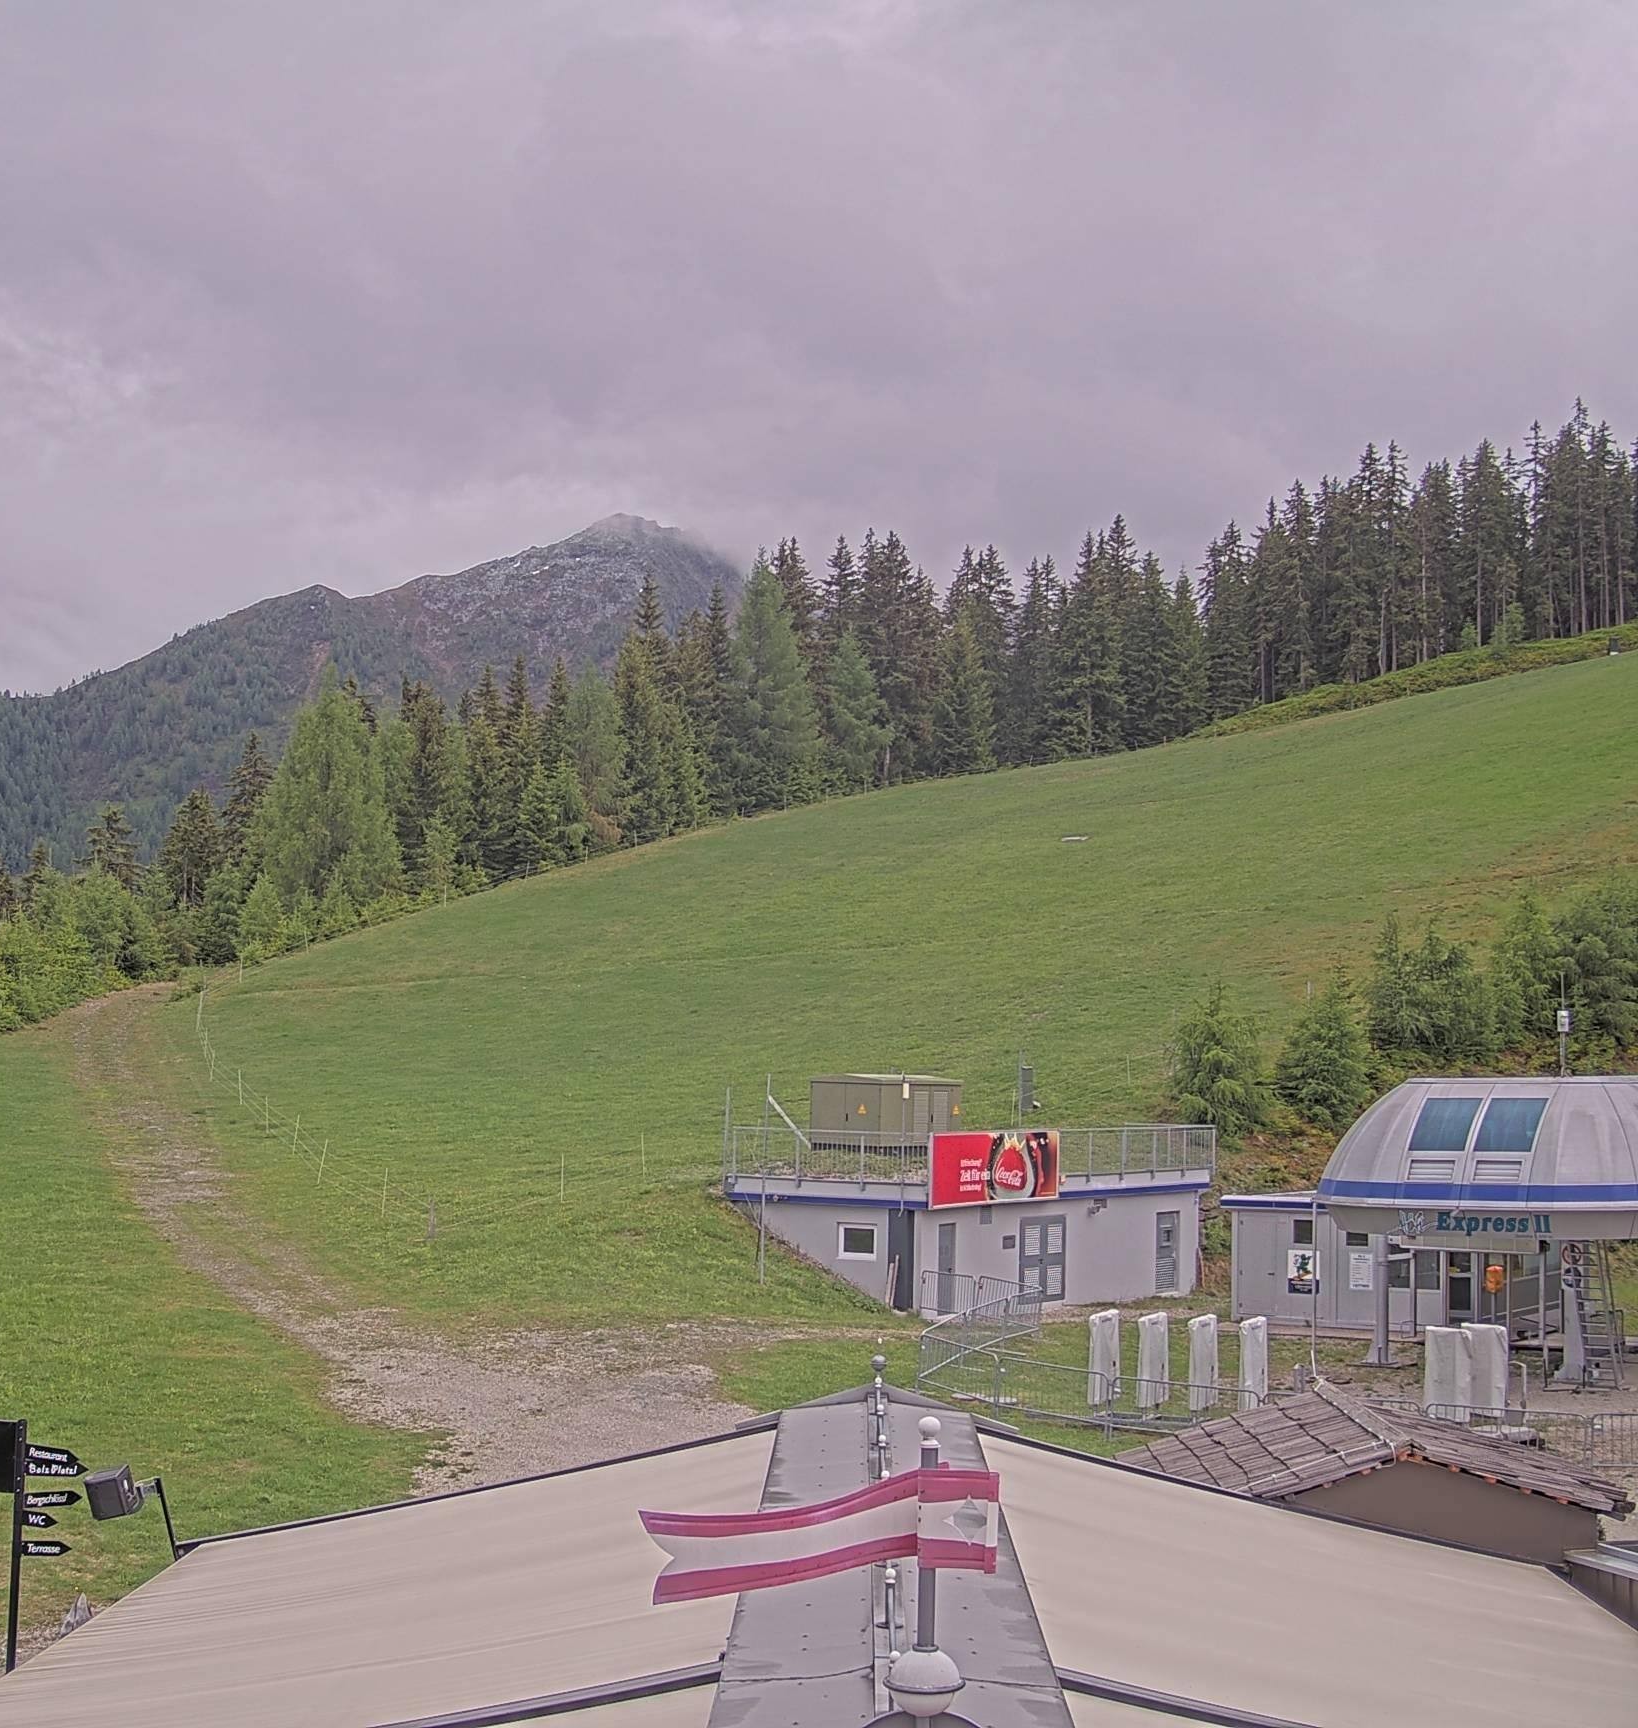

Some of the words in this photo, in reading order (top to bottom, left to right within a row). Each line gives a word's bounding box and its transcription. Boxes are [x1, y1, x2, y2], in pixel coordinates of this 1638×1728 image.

[1436, 1211, 1529, 1236] Express
[29, 1447, 67, 1462] Restaurant
[28, 1514, 47, 1525] WC
[27, 1543, 61, 1554] Terrasse
